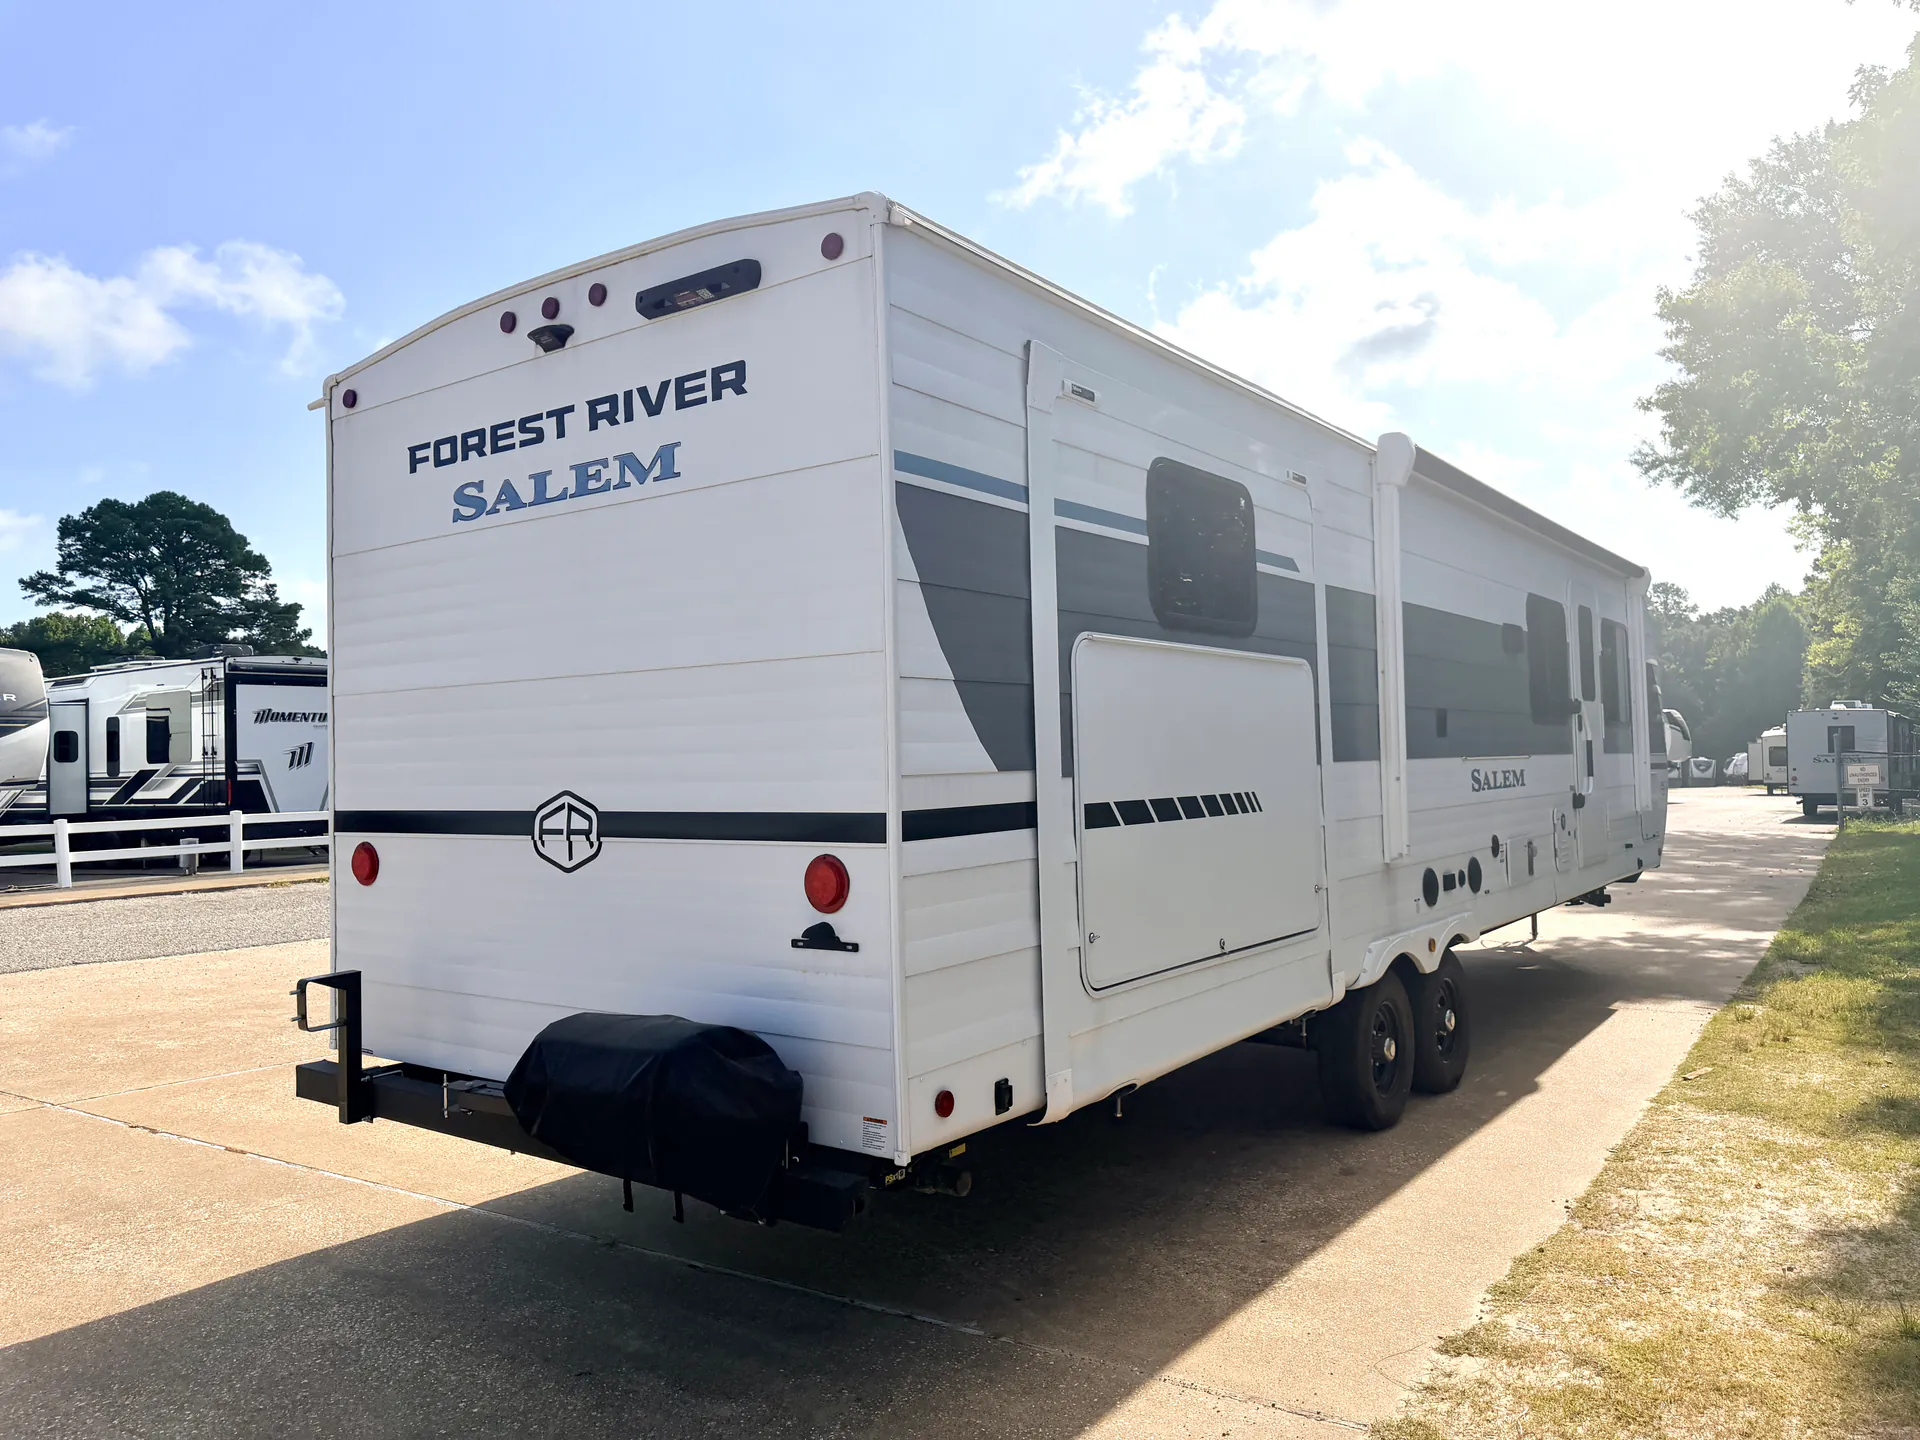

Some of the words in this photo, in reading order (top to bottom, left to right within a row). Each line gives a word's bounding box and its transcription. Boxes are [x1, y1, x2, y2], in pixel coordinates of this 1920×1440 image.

[408, 404, 575, 474] FOREST
[585, 359, 749, 432] RIVER
[451, 441, 682, 524] SALEM
[0, 693, 17, 702] R
[1471, 768, 1526, 793] SALEM
